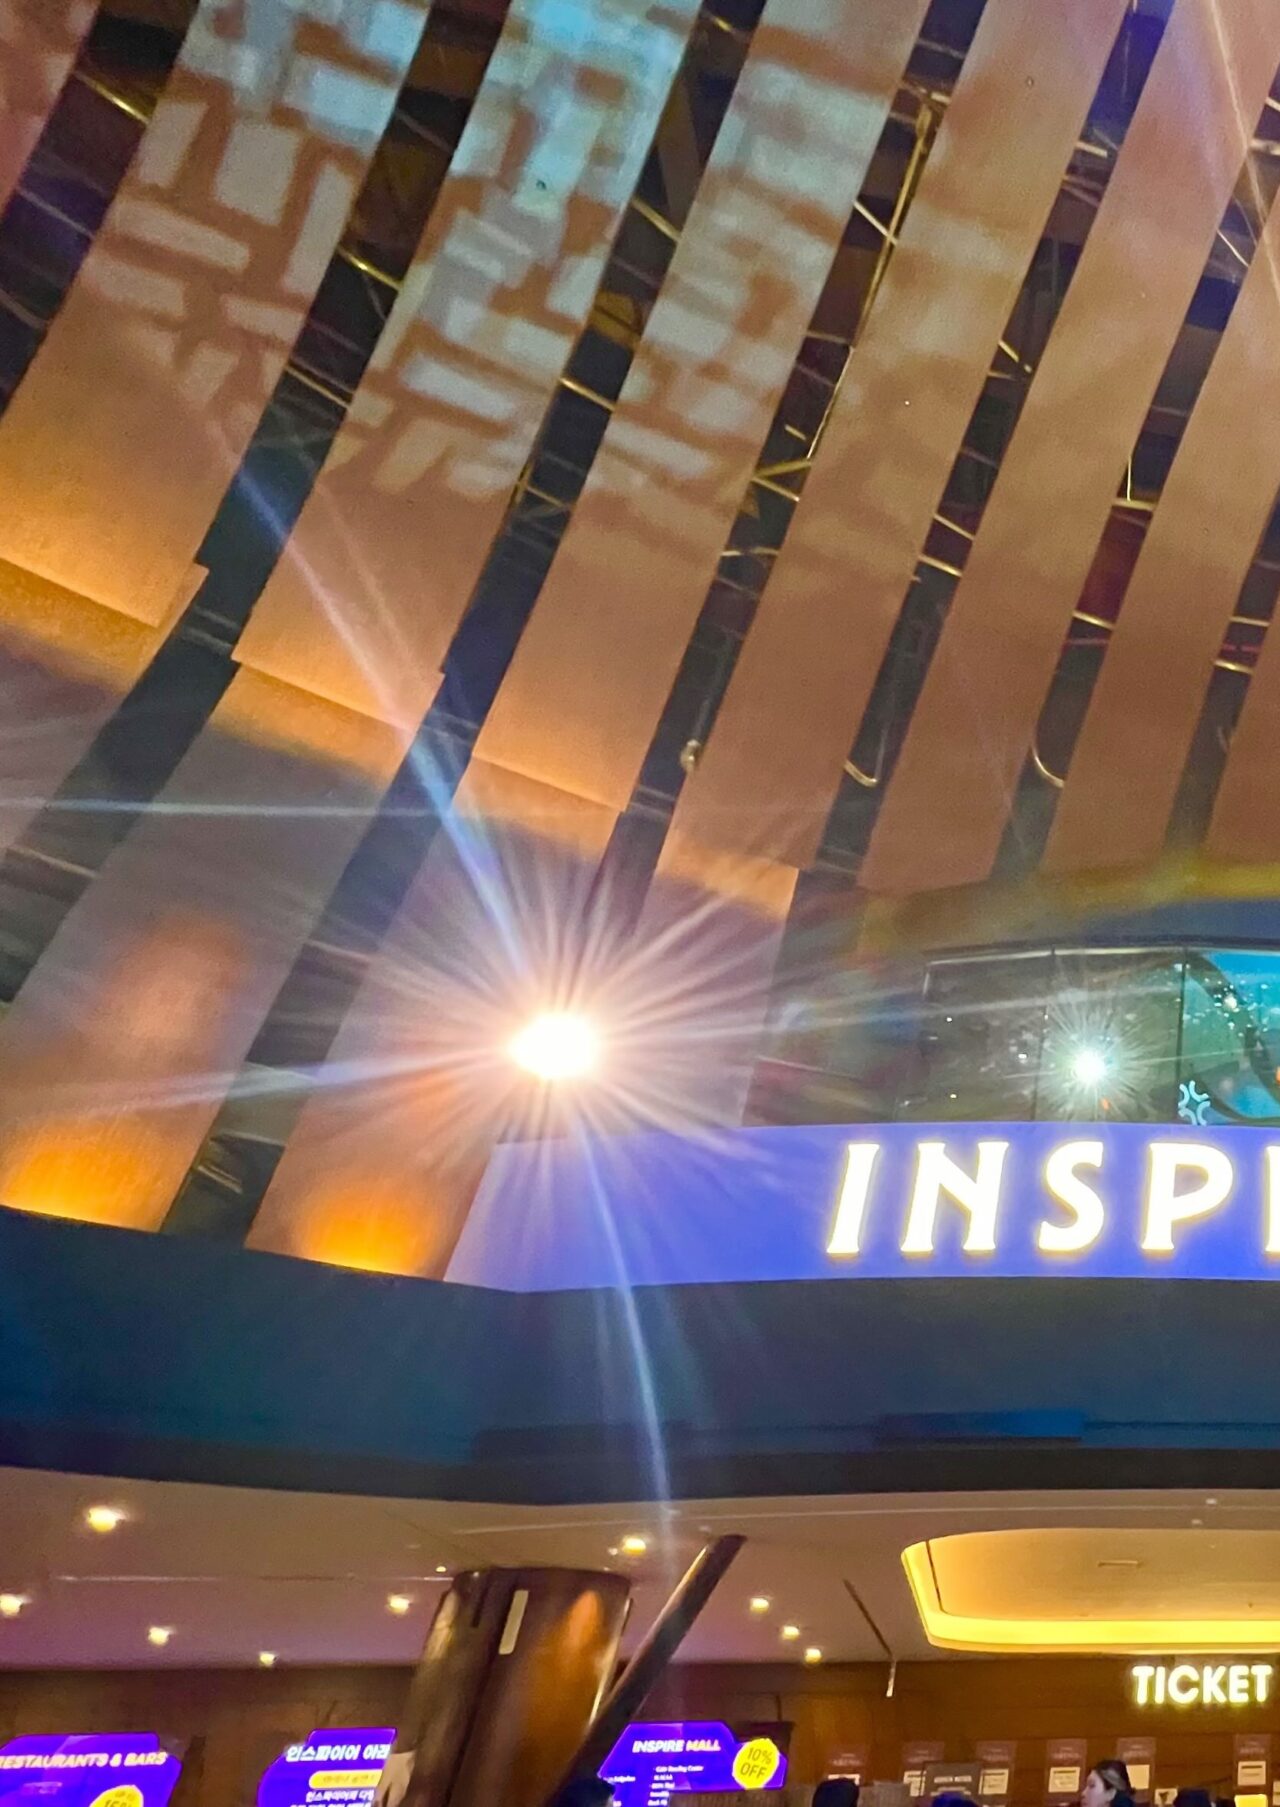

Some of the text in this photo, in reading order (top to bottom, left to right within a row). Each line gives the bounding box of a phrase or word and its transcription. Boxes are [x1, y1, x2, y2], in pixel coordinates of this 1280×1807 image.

[1132, 1665, 1273, 1704] TICKET
[286, 1744, 361, 1762] 인스파이어
[632, 1739, 721, 1753] INSPIRE MALL
[123, 1751, 168, 1767] BARS
[747, 1747, 773, 1764] 10%
[740, 1762, 768, 1779] OFF
